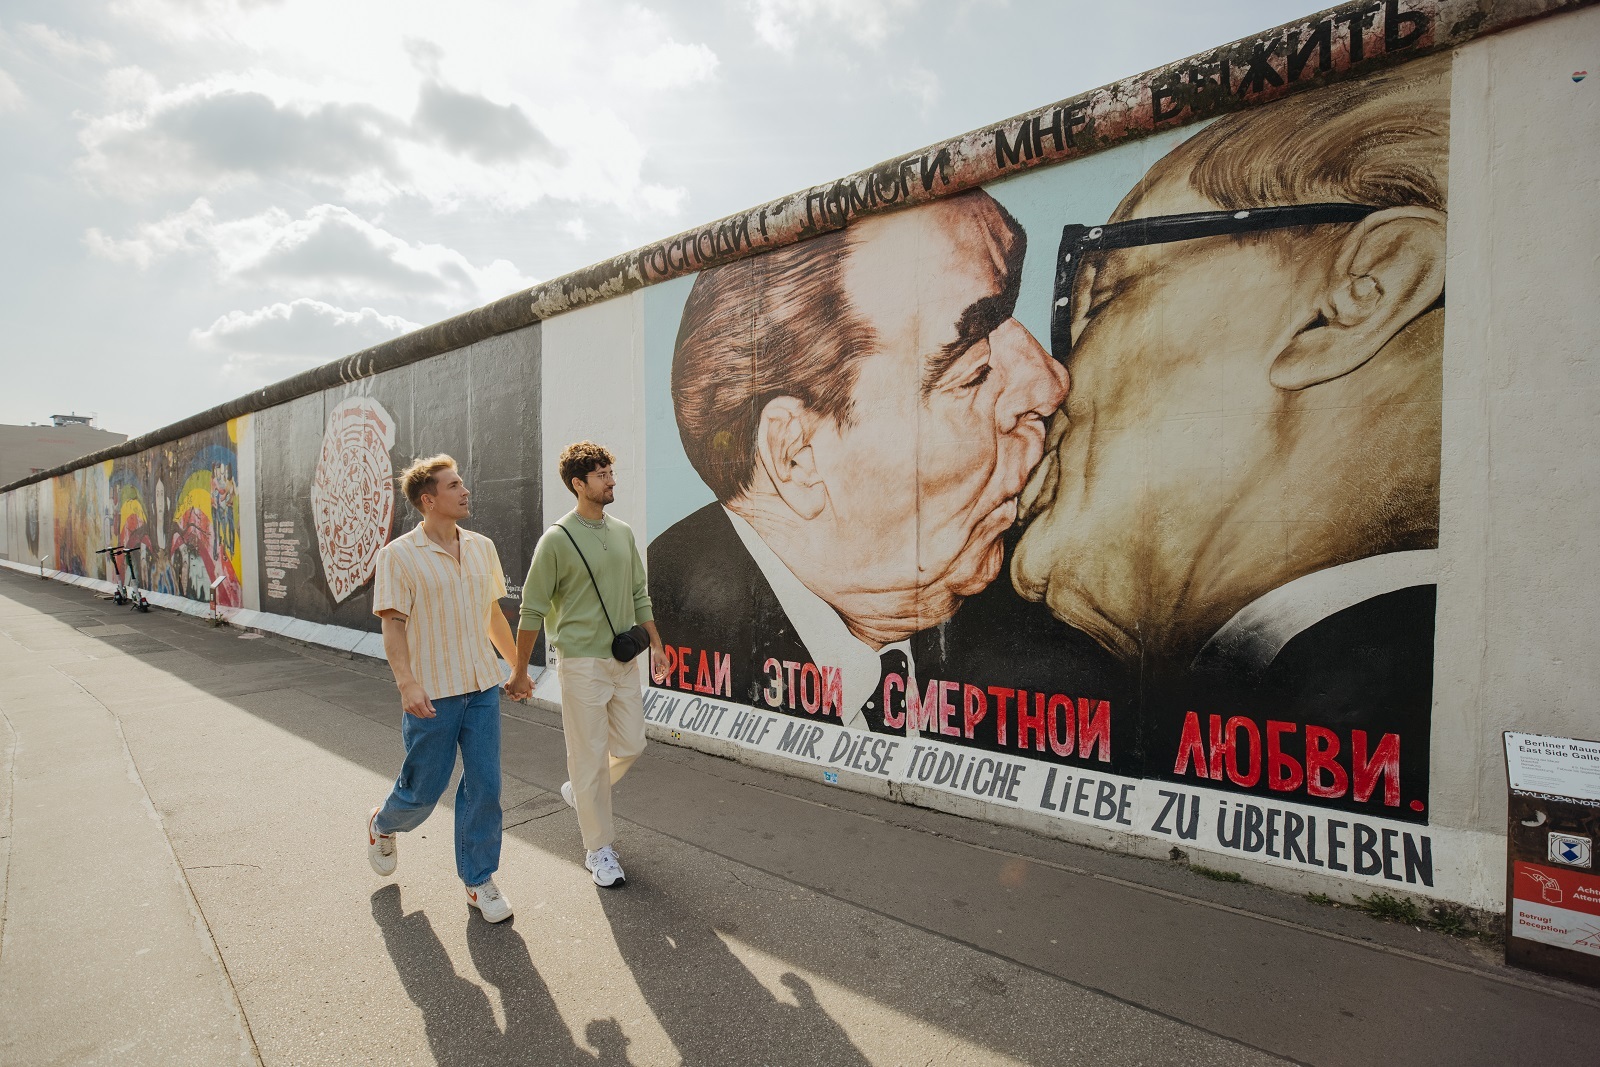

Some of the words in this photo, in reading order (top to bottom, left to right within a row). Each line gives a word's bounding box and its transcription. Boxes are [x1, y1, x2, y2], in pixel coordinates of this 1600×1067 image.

[1524, 739, 1566, 750] Berliner
[1519, 745, 1542, 754] East
[1545, 748, 1568, 758] Side
[1151, 790, 1200, 840] ZU
[1217, 800, 1435, 888] ÜBERLEBEN
[1577, 886, 1600, 895] Acht
[1519, 911, 1552, 924] Betrug!
[1519, 918, 1568, 935] Deception!
